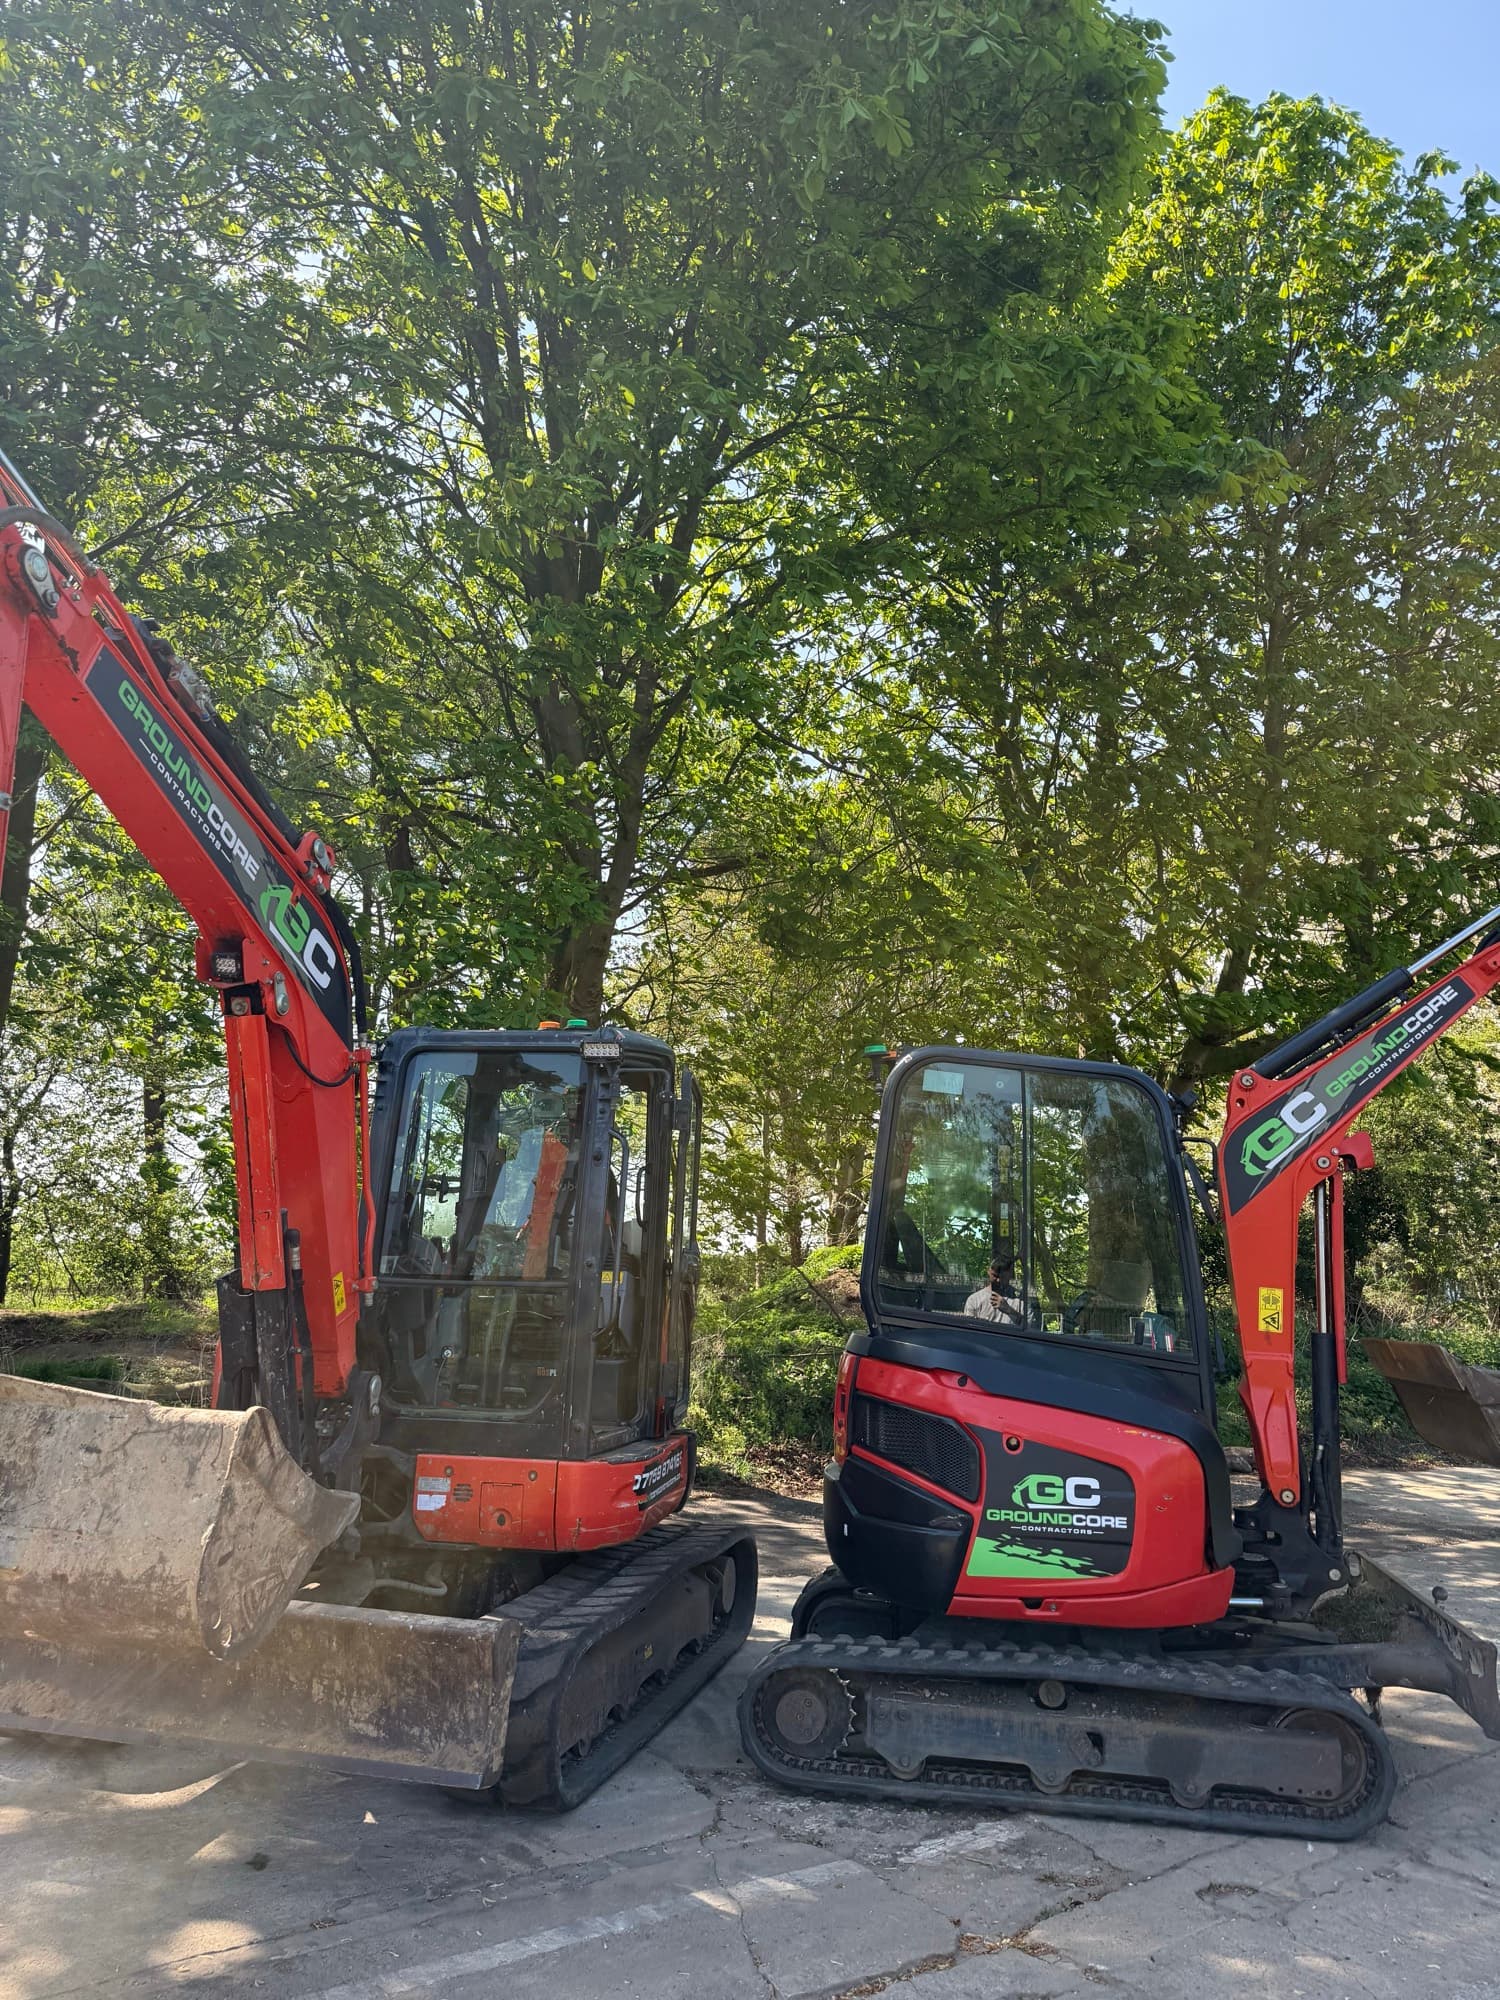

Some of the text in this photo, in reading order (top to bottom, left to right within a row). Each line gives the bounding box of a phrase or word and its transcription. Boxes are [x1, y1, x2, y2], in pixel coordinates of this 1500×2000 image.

[118, 679, 260, 882] GROUNDCORE
[150, 753, 222, 850] CONTRACTORS
[264, 885, 336, 988] GC
[1324, 985, 1459, 1098] GROUNDCORE
[1368, 1023, 1434, 1079] CONTRACTORS
[1245, 1091, 1327, 1165] GC
[986, 1508, 1128, 1529] GROUNDCORE
[1026, 1474, 1101, 1507] GC
[1021, 1525, 1093, 1535] CONTRACTORS
